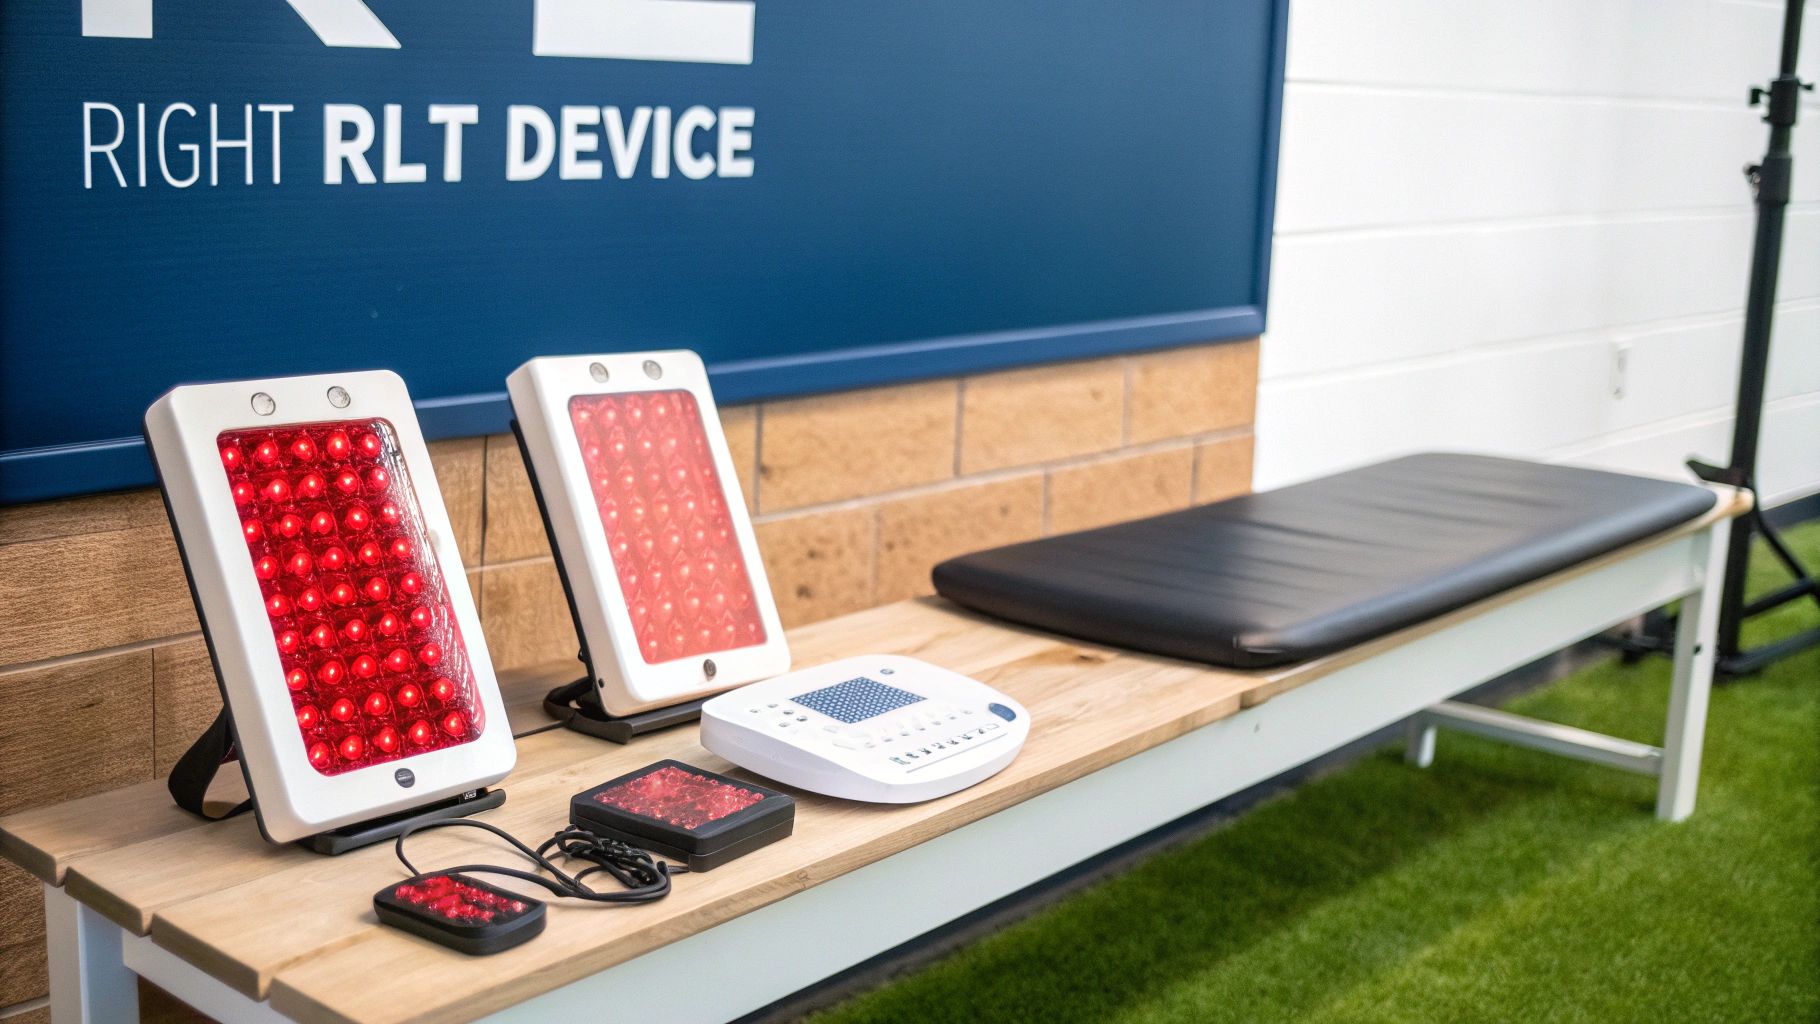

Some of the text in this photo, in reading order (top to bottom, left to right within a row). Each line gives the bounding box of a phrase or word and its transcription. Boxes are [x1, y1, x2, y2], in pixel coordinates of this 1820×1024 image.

[83, 102, 755, 188] RIGHT RLT DEVICE
